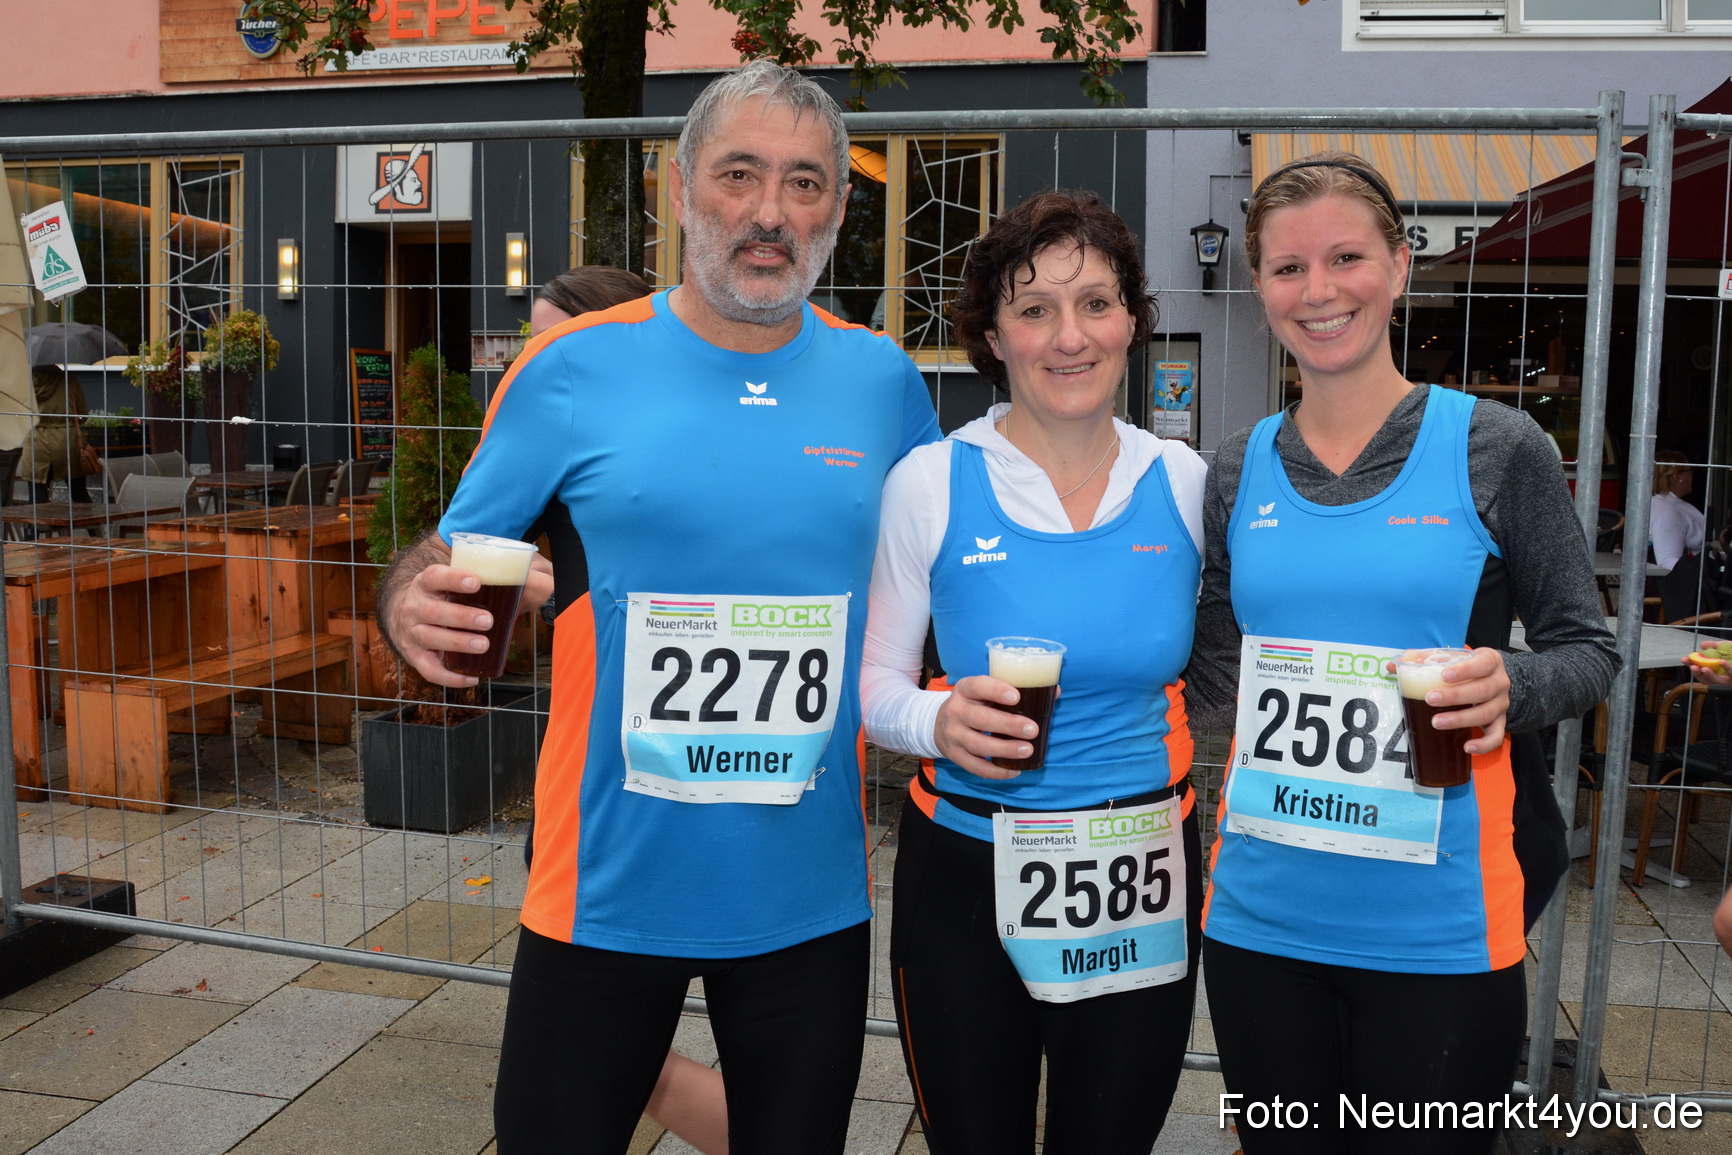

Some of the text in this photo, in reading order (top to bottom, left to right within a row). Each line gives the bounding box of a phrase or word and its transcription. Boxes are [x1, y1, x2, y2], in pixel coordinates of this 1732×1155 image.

[739, 395, 778, 406] erima
[823, 457, 859, 468] Werner
[1249, 518, 1279, 530] erima
[1387, 515, 1449, 526] Coole Silke
[1132, 543, 1169, 554] Margit
[962, 551, 1007, 566] erima
[730, 603, 833, 629] BOCK
[645, 617, 718, 631] NeuerMarkt
[730, 629, 764, 638] inspired
[765, 629, 776, 638] by
[803, 630, 833, 638] concepts
[1256, 660, 1315, 676] NeuerMarkt
[1326, 650, 1399, 682] BOC
[650, 646, 829, 723] 2278
[1325, 676, 1395, 691] inspired by smart
[632, 715, 642, 729] D
[1253, 687, 1415, 779] 2584
[686, 745, 793, 774] Werner
[1241, 753, 1249, 766] D
[1272, 784, 1380, 828] Kristina
[1088, 806, 1173, 841] BOCK
[1011, 834, 1078, 846] NeuerMarkt
[1088, 840, 1118, 849] inspired
[1119, 838, 1129, 846] by
[1129, 835, 1148, 845] smart
[1019, 847, 1172, 929] 2585
[1006, 924, 1015, 936] D
[1061, 938, 1138, 975] Margit
